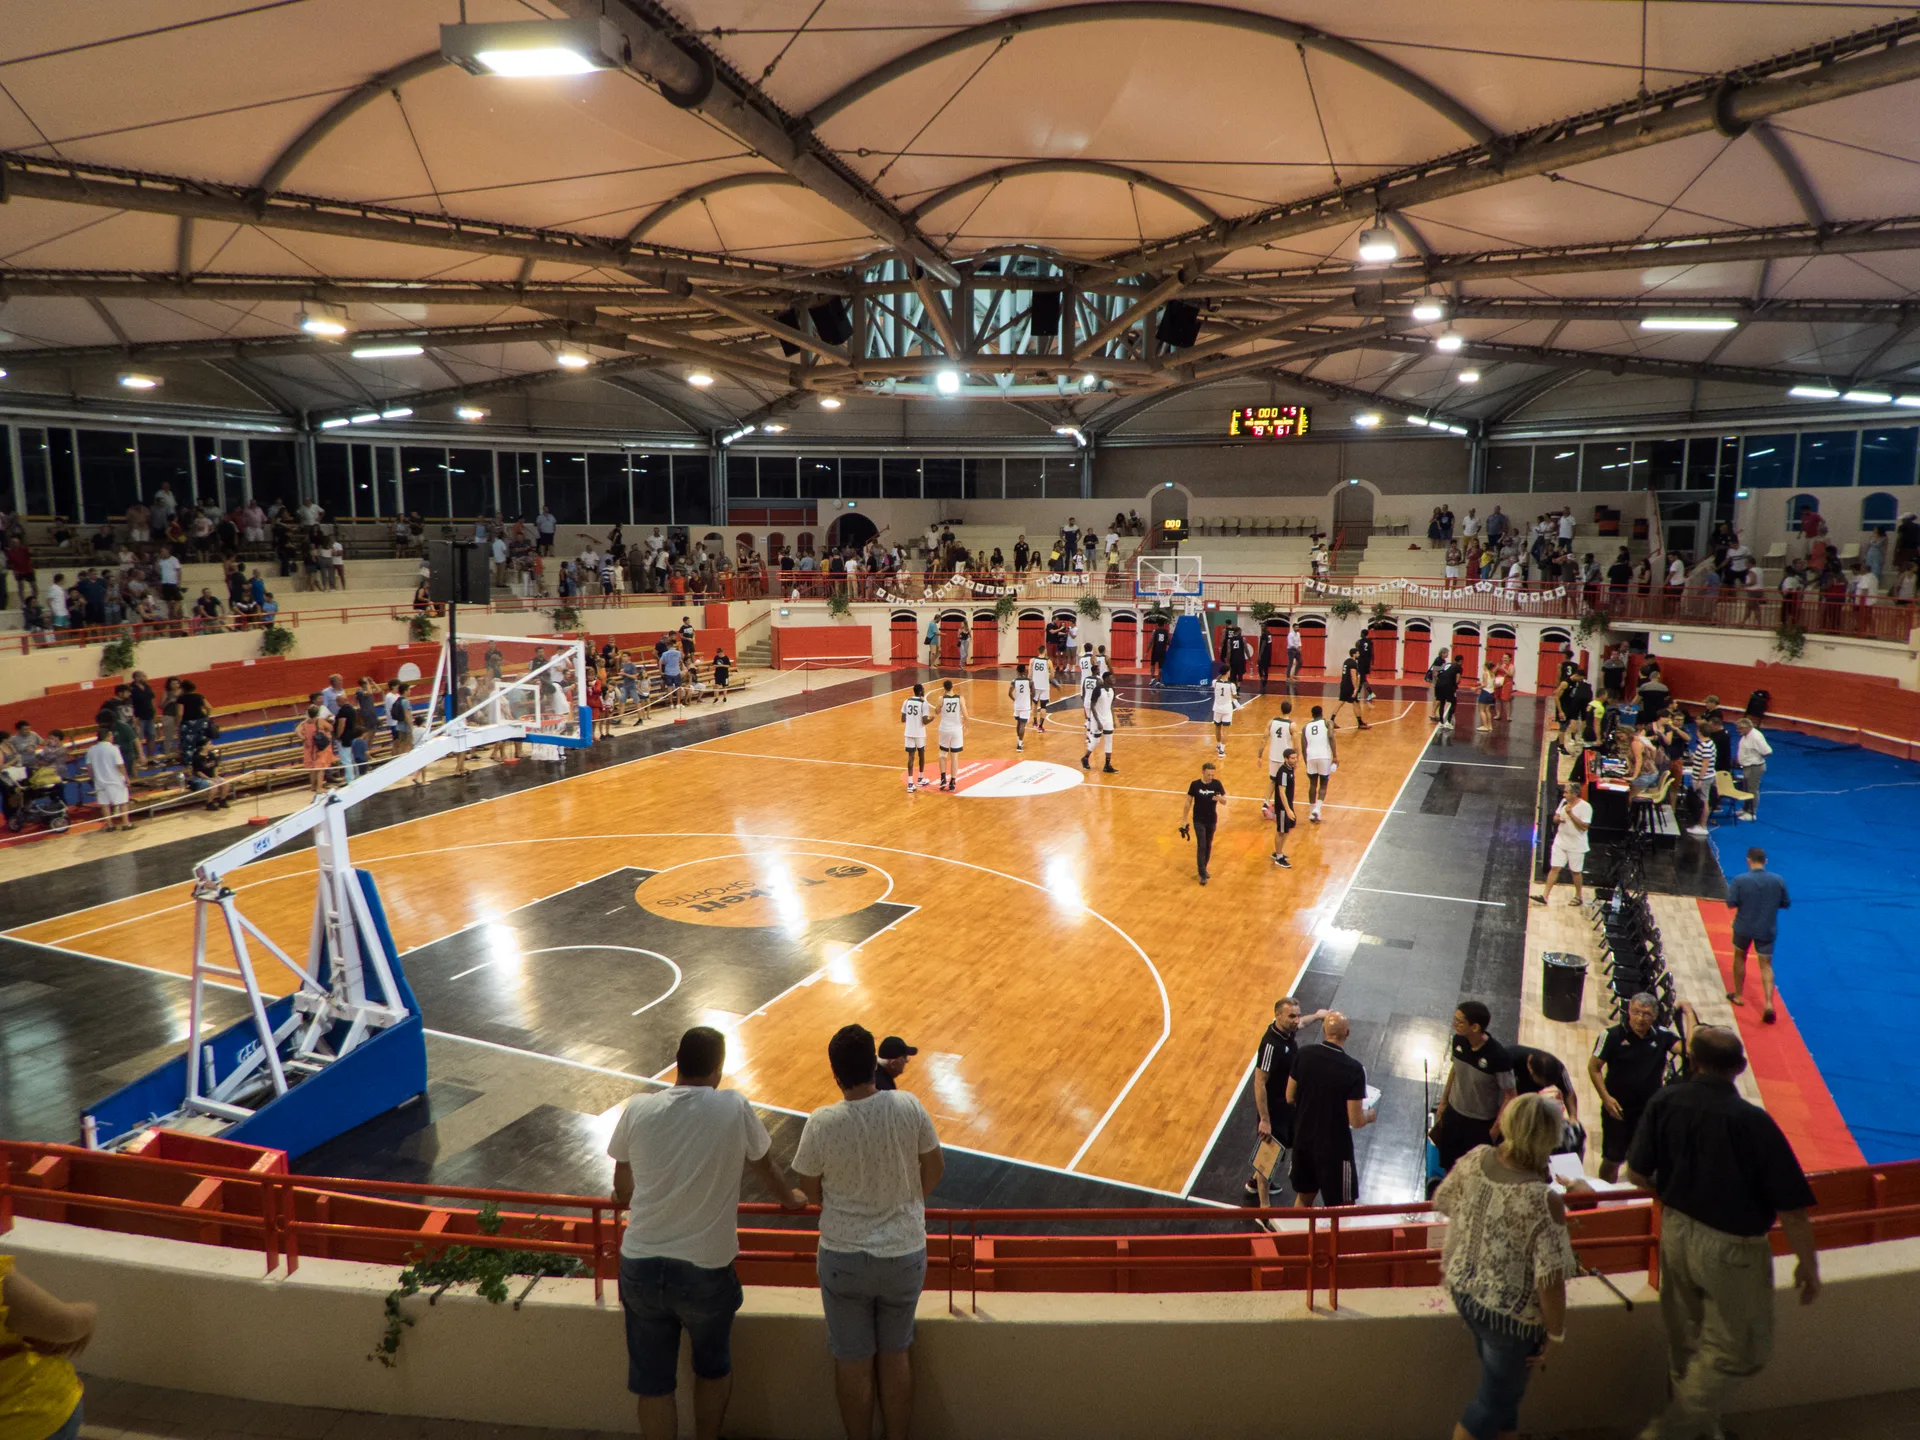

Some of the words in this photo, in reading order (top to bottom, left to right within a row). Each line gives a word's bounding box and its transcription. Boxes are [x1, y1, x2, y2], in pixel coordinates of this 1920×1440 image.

[1034, 662, 1045, 672] 66
[1080, 660, 1089, 670] 12
[1566, 665, 1572, 676] 3
[1019, 684, 1025, 694] 2
[1085, 680, 1095, 690] 25
[907, 704, 919, 716] 35
[945, 702, 957, 713] 37
[1275, 726, 1283, 739] 4
[1311, 725, 1319, 736] 8
[656, 879, 756, 908] SPORTS
